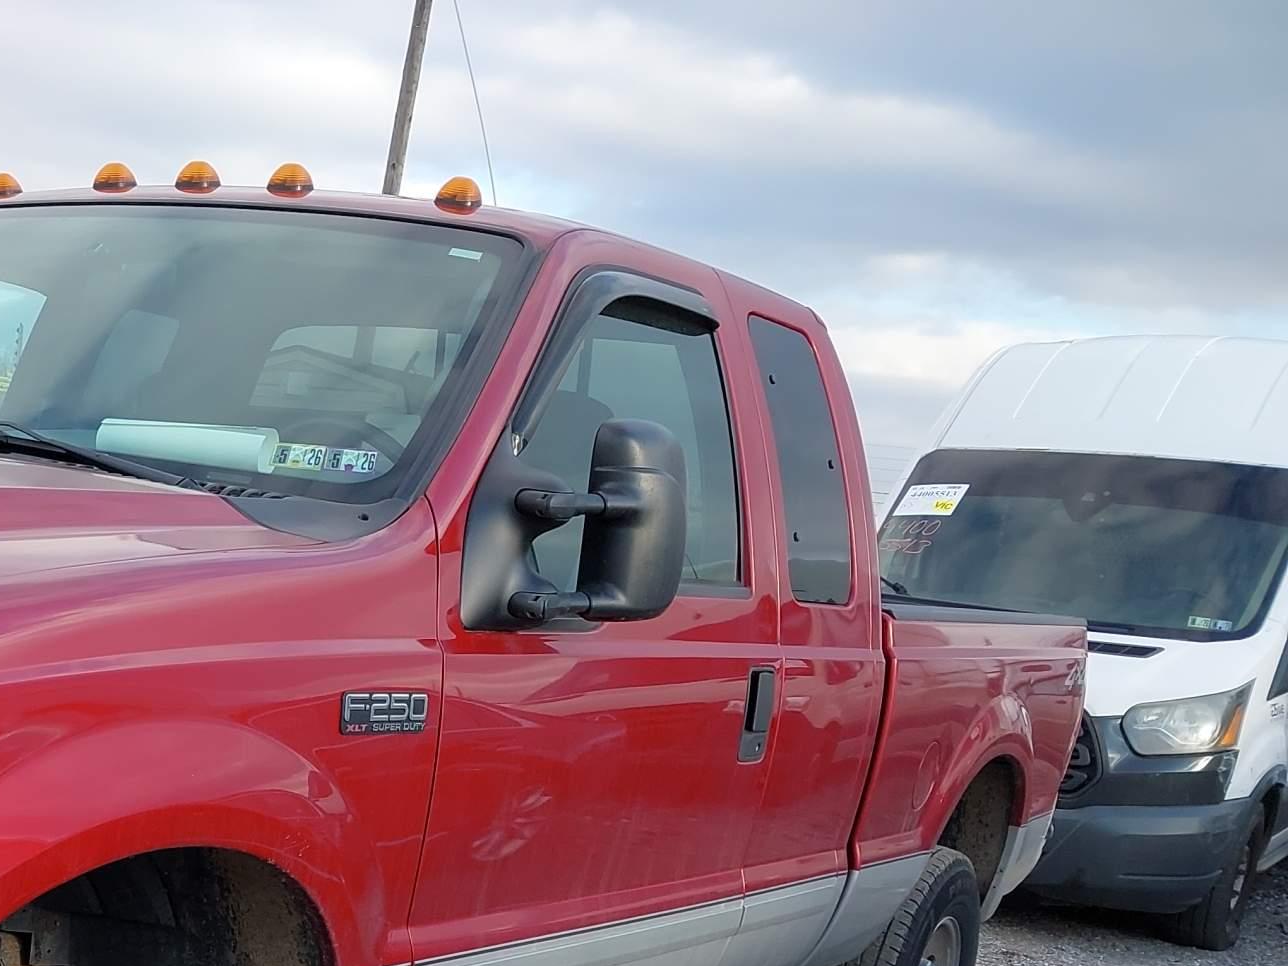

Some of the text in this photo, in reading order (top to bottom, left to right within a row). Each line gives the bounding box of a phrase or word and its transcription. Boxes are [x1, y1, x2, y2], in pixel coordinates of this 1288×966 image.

[308, 449, 322, 466] 26
[361, 453, 375, 470] 26
[346, 724, 368, 732] XLT
[372, 722, 426, 731] SUPER DUTY
